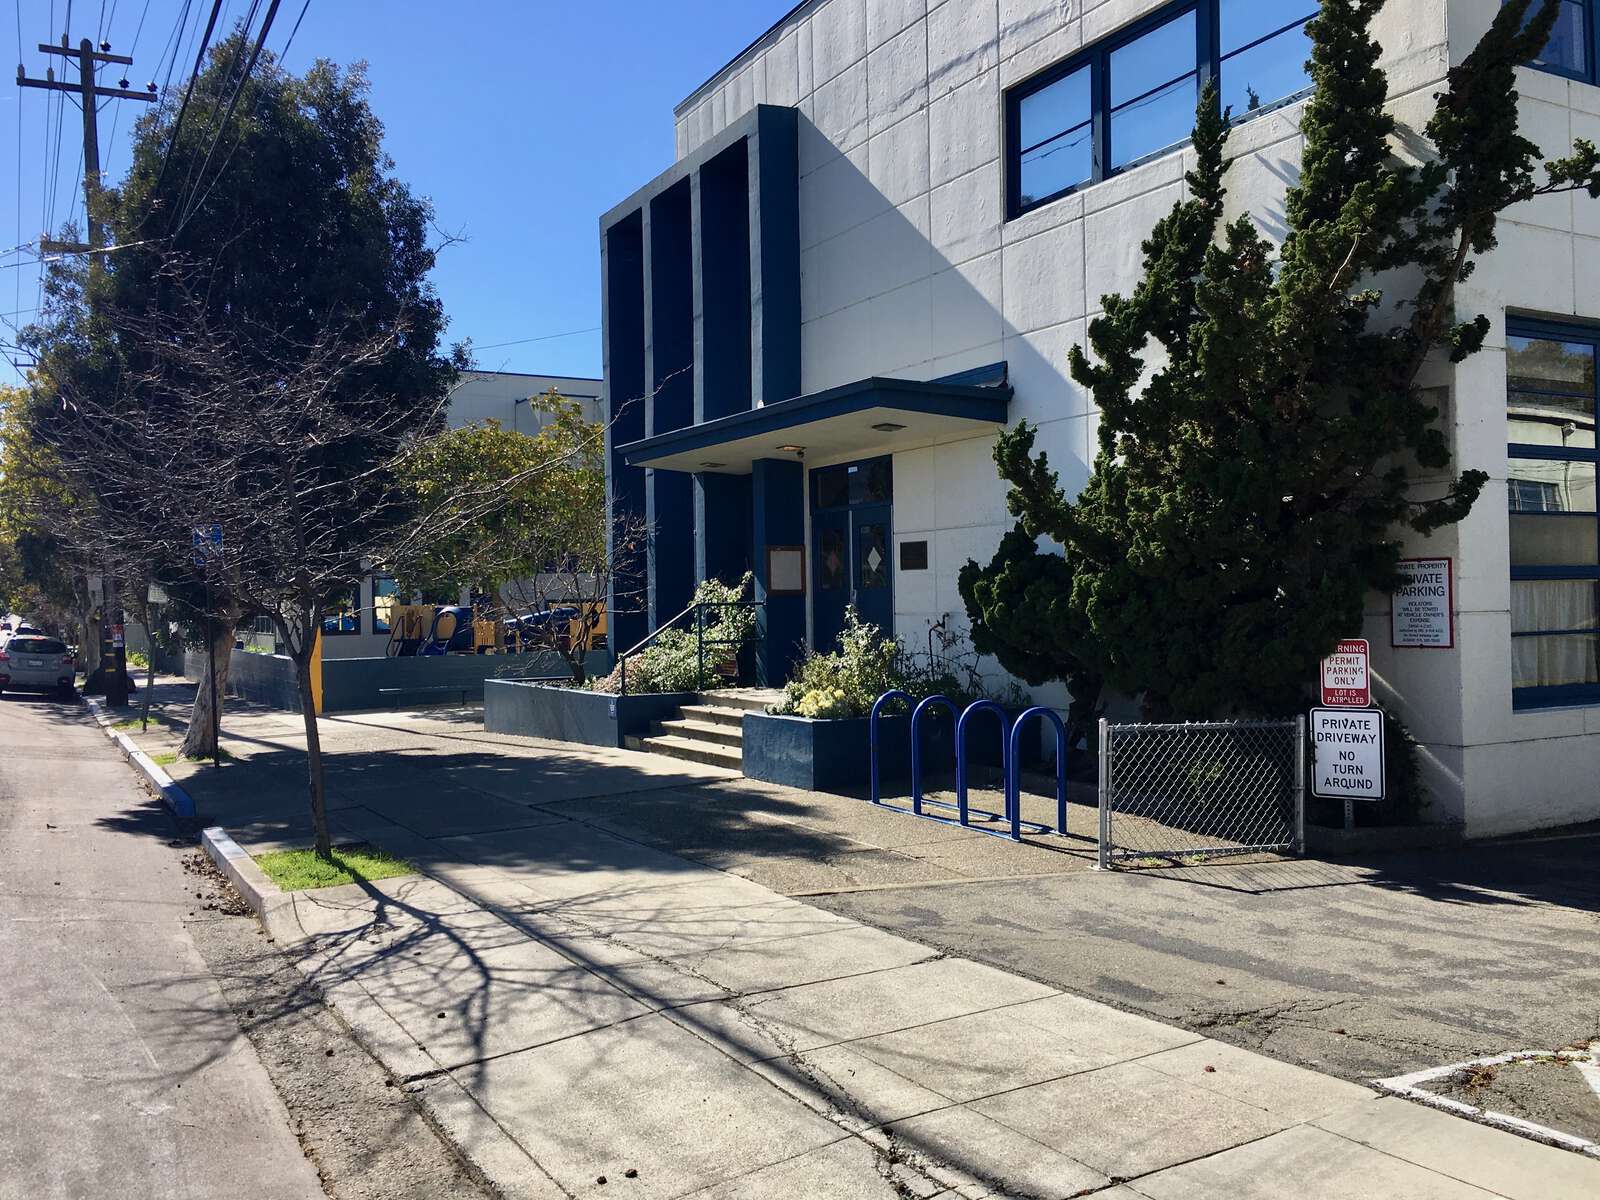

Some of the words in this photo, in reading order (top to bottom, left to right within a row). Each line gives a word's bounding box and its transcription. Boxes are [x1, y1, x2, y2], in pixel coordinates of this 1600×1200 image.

[1405, 573, 1443, 584] IVATE
[1396, 586, 1445, 596] PARKING
[1335, 644, 1365, 653] RNING
[1329, 656, 1360, 665] PERMIT
[1326, 666, 1363, 675] PARKING
[1334, 676, 1356, 685] ONLY
[1334, 689, 1347, 697] LOT
[1349, 689, 1357, 697] IS
[1327, 696, 1364, 704] PATROLLED
[1322, 718, 1371, 730] PRIVATE
[1316, 732, 1377, 744] DRIVEWAY
[1338, 750, 1355, 761] NO
[1332, 763, 1363, 775] TURN
[1324, 777, 1373, 789] AROUND
